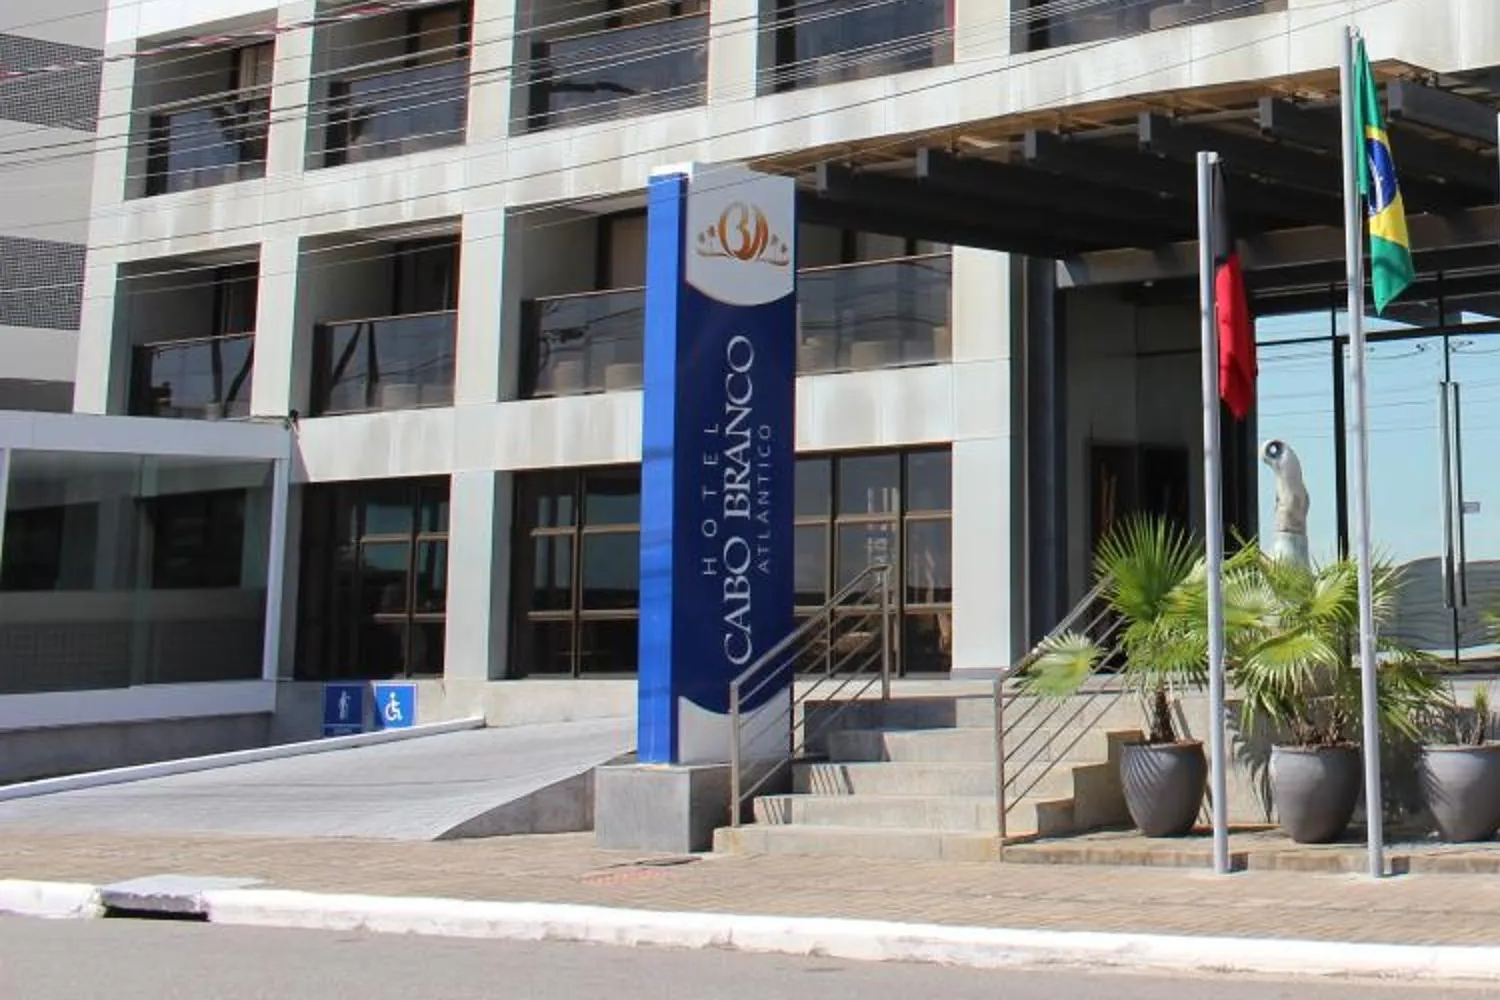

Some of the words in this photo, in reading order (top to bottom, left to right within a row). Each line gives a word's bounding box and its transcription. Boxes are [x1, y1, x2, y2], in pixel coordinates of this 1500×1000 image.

[702, 422, 719, 577] HOTEL
[723, 335, 755, 520] BRANCO
[723, 535, 753, 665] CABO
